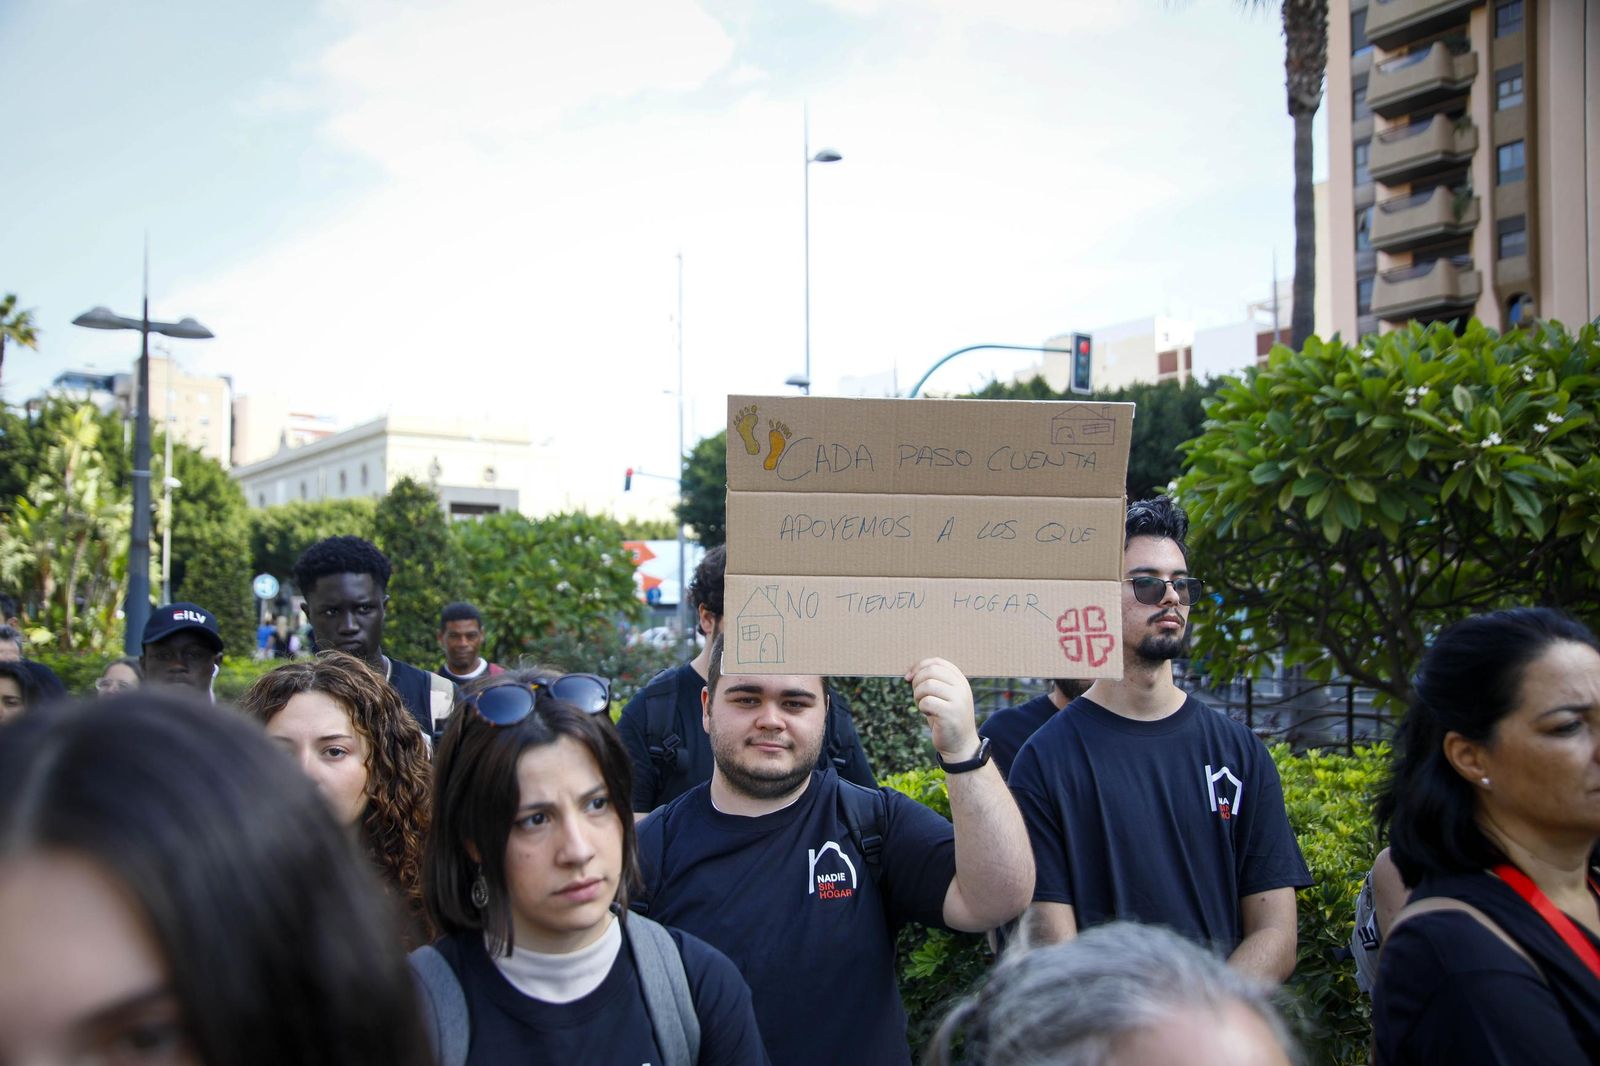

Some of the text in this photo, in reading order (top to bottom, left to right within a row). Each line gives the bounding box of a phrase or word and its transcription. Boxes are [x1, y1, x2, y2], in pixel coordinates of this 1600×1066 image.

[777, 437, 1097, 481] CADA PASO CUENTA
[780, 514, 1097, 543] APOYEMOS A LOS QUE
[787, 586, 1054, 622] NO TIENEN HOGAR
[817, 872, 846, 883] NADIE
[818, 882, 835, 891] SIN
[819, 888, 852, 899] HOGAR
